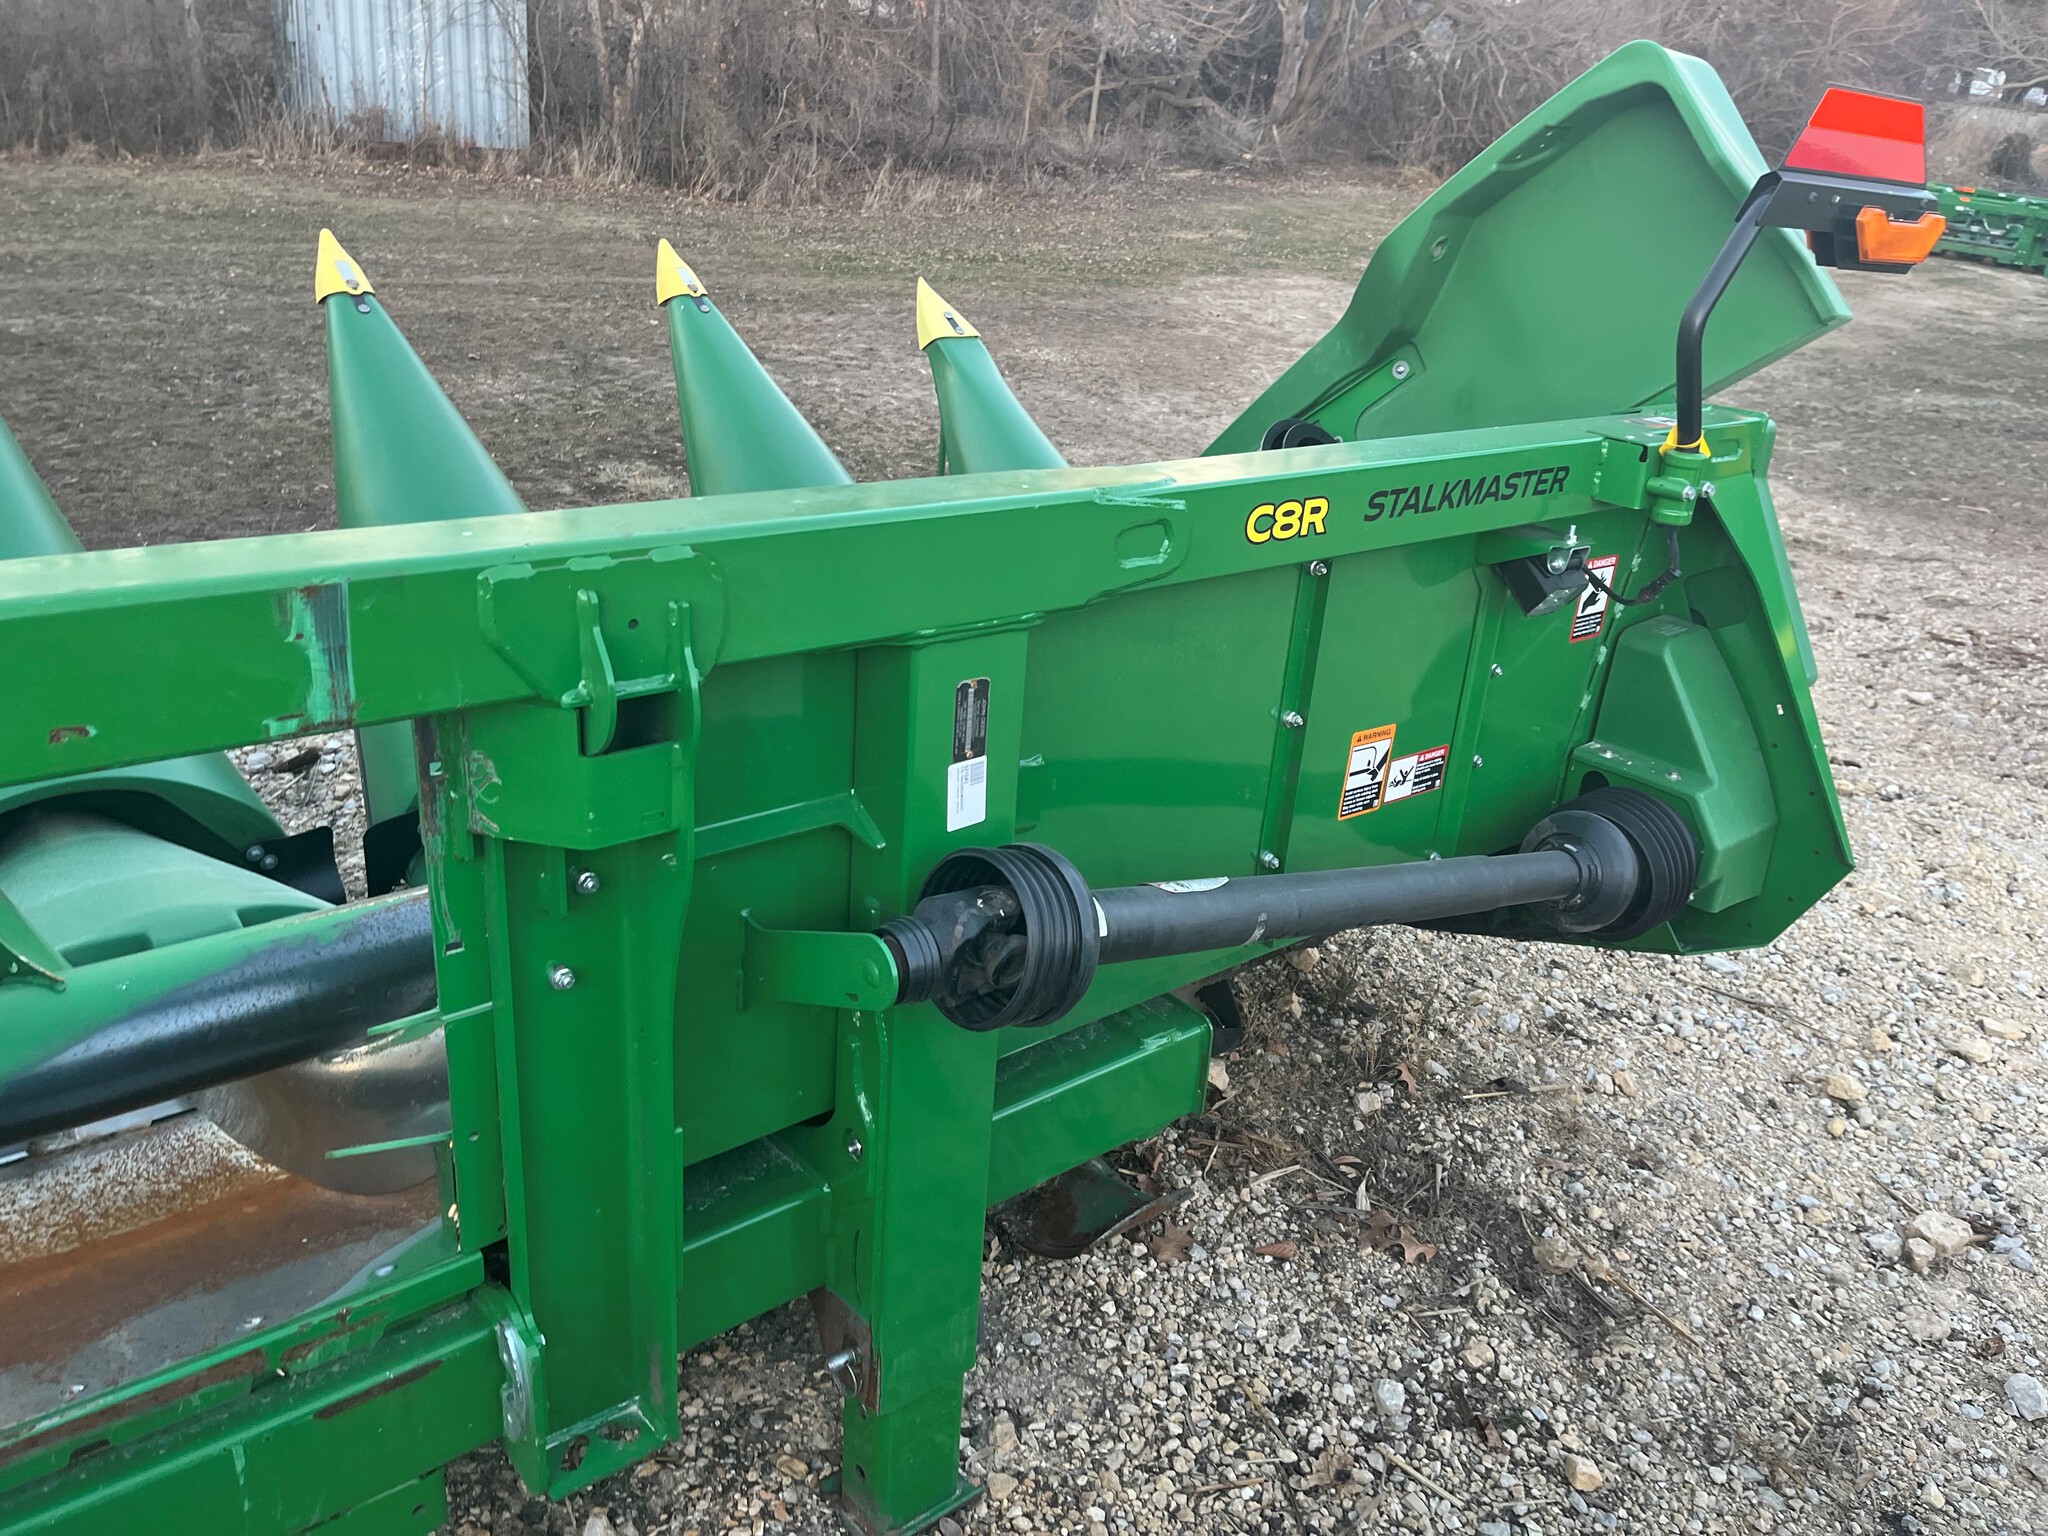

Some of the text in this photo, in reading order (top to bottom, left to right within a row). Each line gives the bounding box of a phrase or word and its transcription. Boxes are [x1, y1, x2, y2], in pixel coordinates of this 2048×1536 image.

[1245, 465, 1570, 545] C8R STALKMASTER
[1593, 556, 1617, 568] DANGER
[1363, 728, 1391, 741] WARNING
[1425, 748, 1445, 760] DANGER
